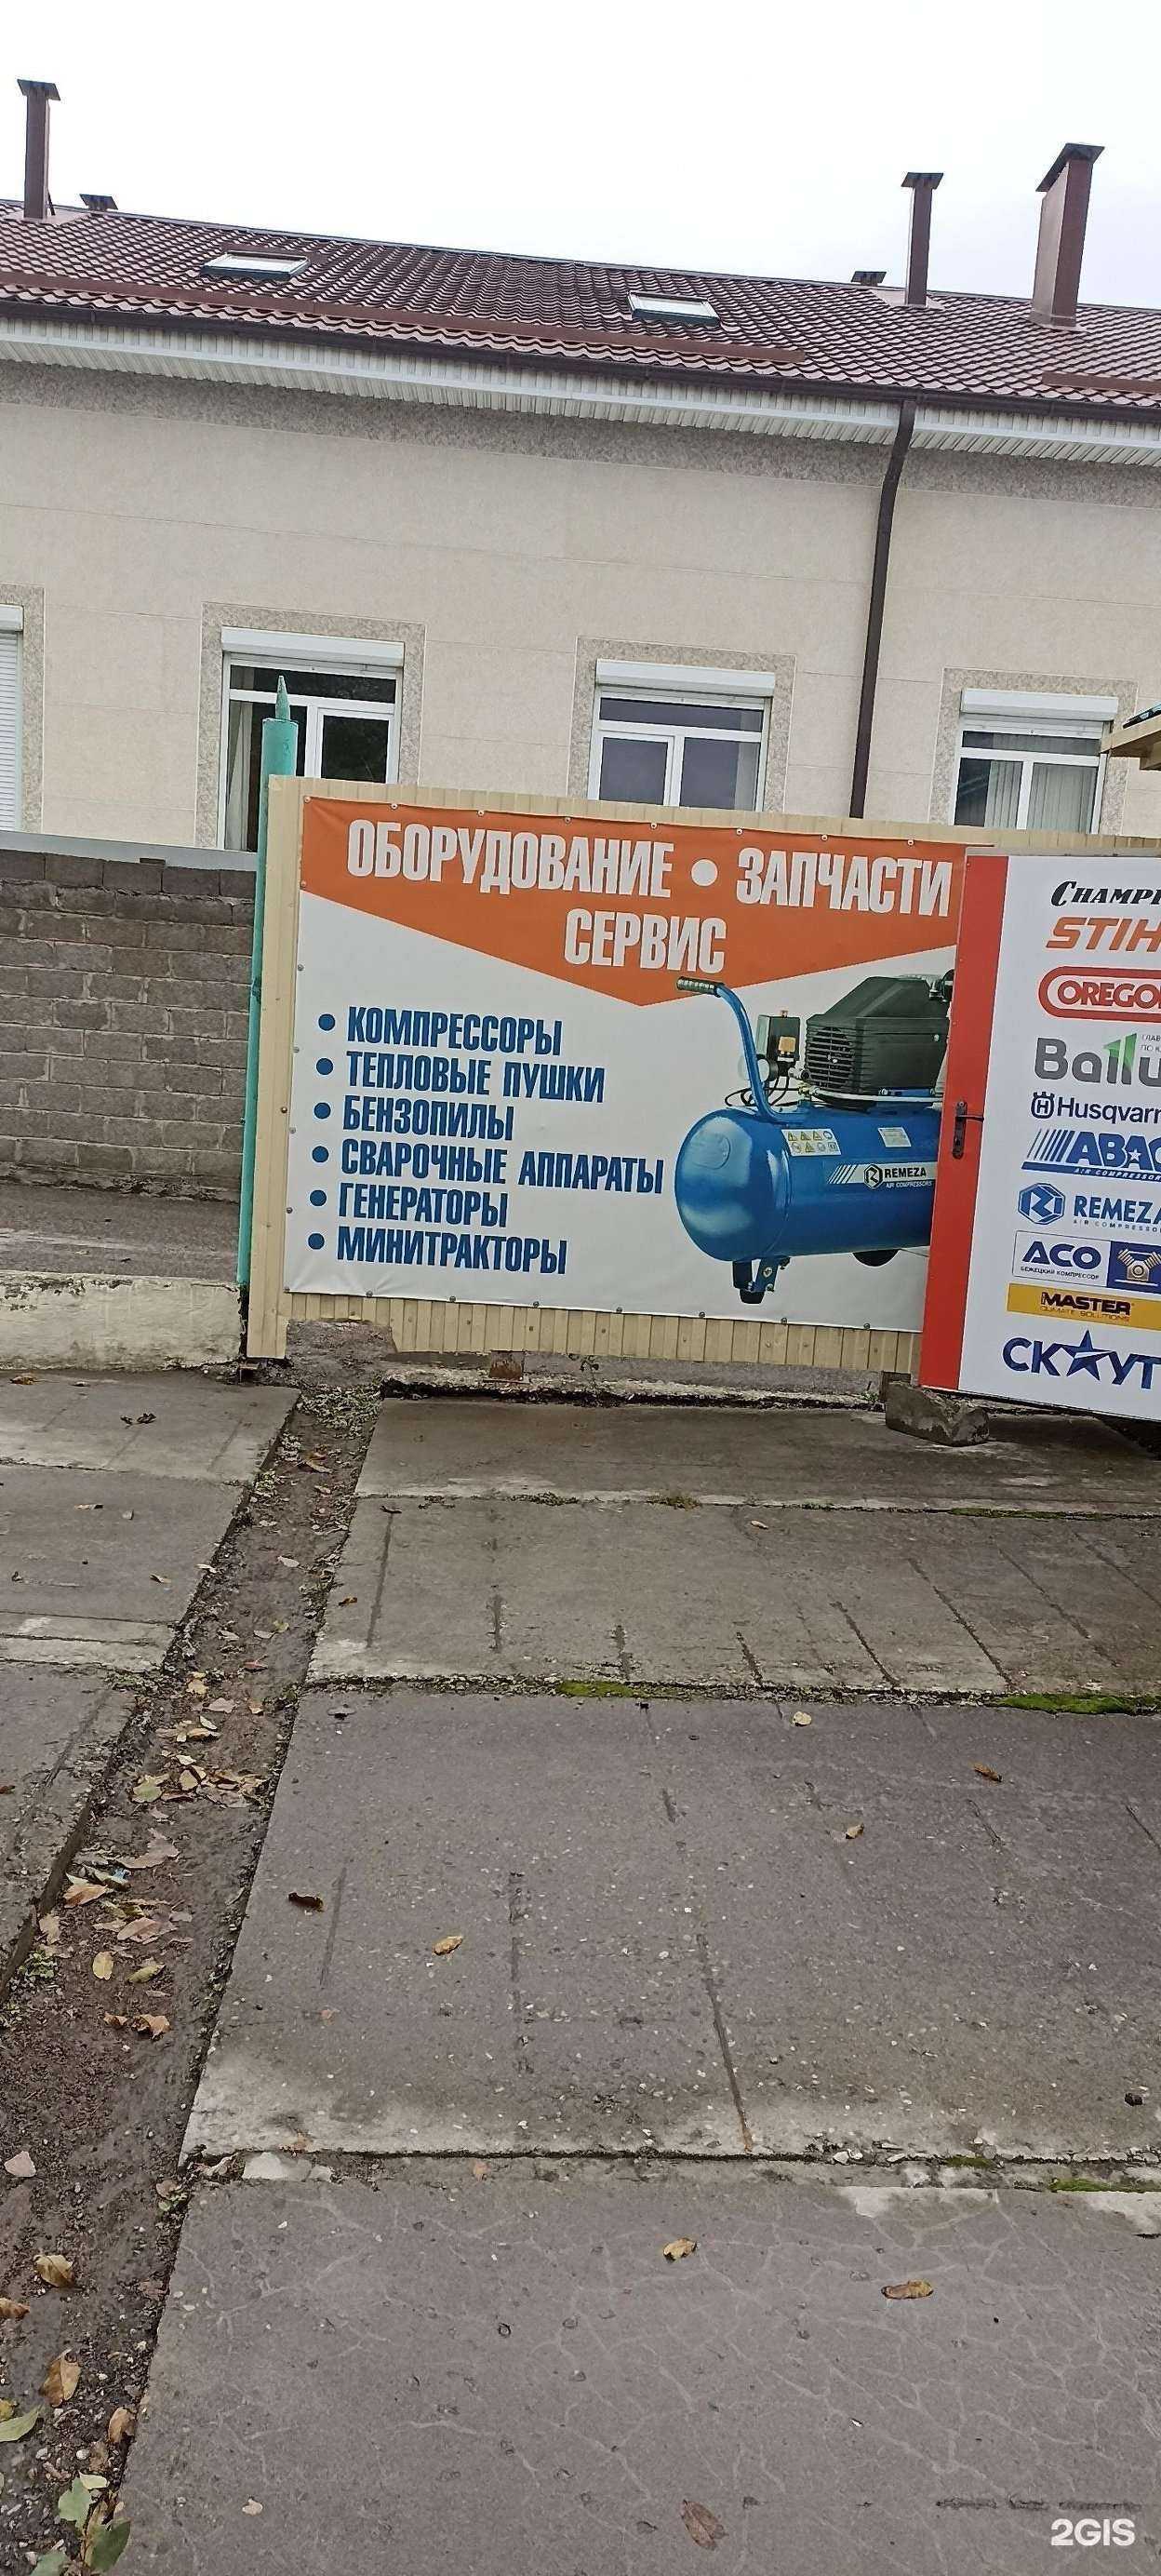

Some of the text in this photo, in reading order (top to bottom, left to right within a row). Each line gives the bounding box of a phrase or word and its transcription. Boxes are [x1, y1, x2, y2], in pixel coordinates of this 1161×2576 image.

[346, 818, 954, 918] ОБОРУДОВАНИЕ ЗАПЧАСТИ
[563, 908, 727, 974] СЕРВИС
[1057, 980, 1161, 1010] OREGO
[347, 1006, 563, 1056] КОМПРЕССОРЫ
[347, 1052, 605, 1103] ТЕПЛОВЫЕ ПУШКИ
[342, 1095, 514, 1141] БЕНЗОПИЛЫ
[341, 1139, 663, 1194] СВАРОЧНЫЕ АППАРАТЫ
[884, 1167, 927, 1178] REMEZA
[338, 1183, 508, 1228] ГЕНЕРАТОРЫ
[1094, 1220, 1161, 1233] COMPRESSO
[337, 1226, 567, 1275] МИНИТРАКТОРЫ
[1056, 1270, 1100, 1281] КОМПРЕССОР
[1040, 1292, 1131, 1316] MASTER
